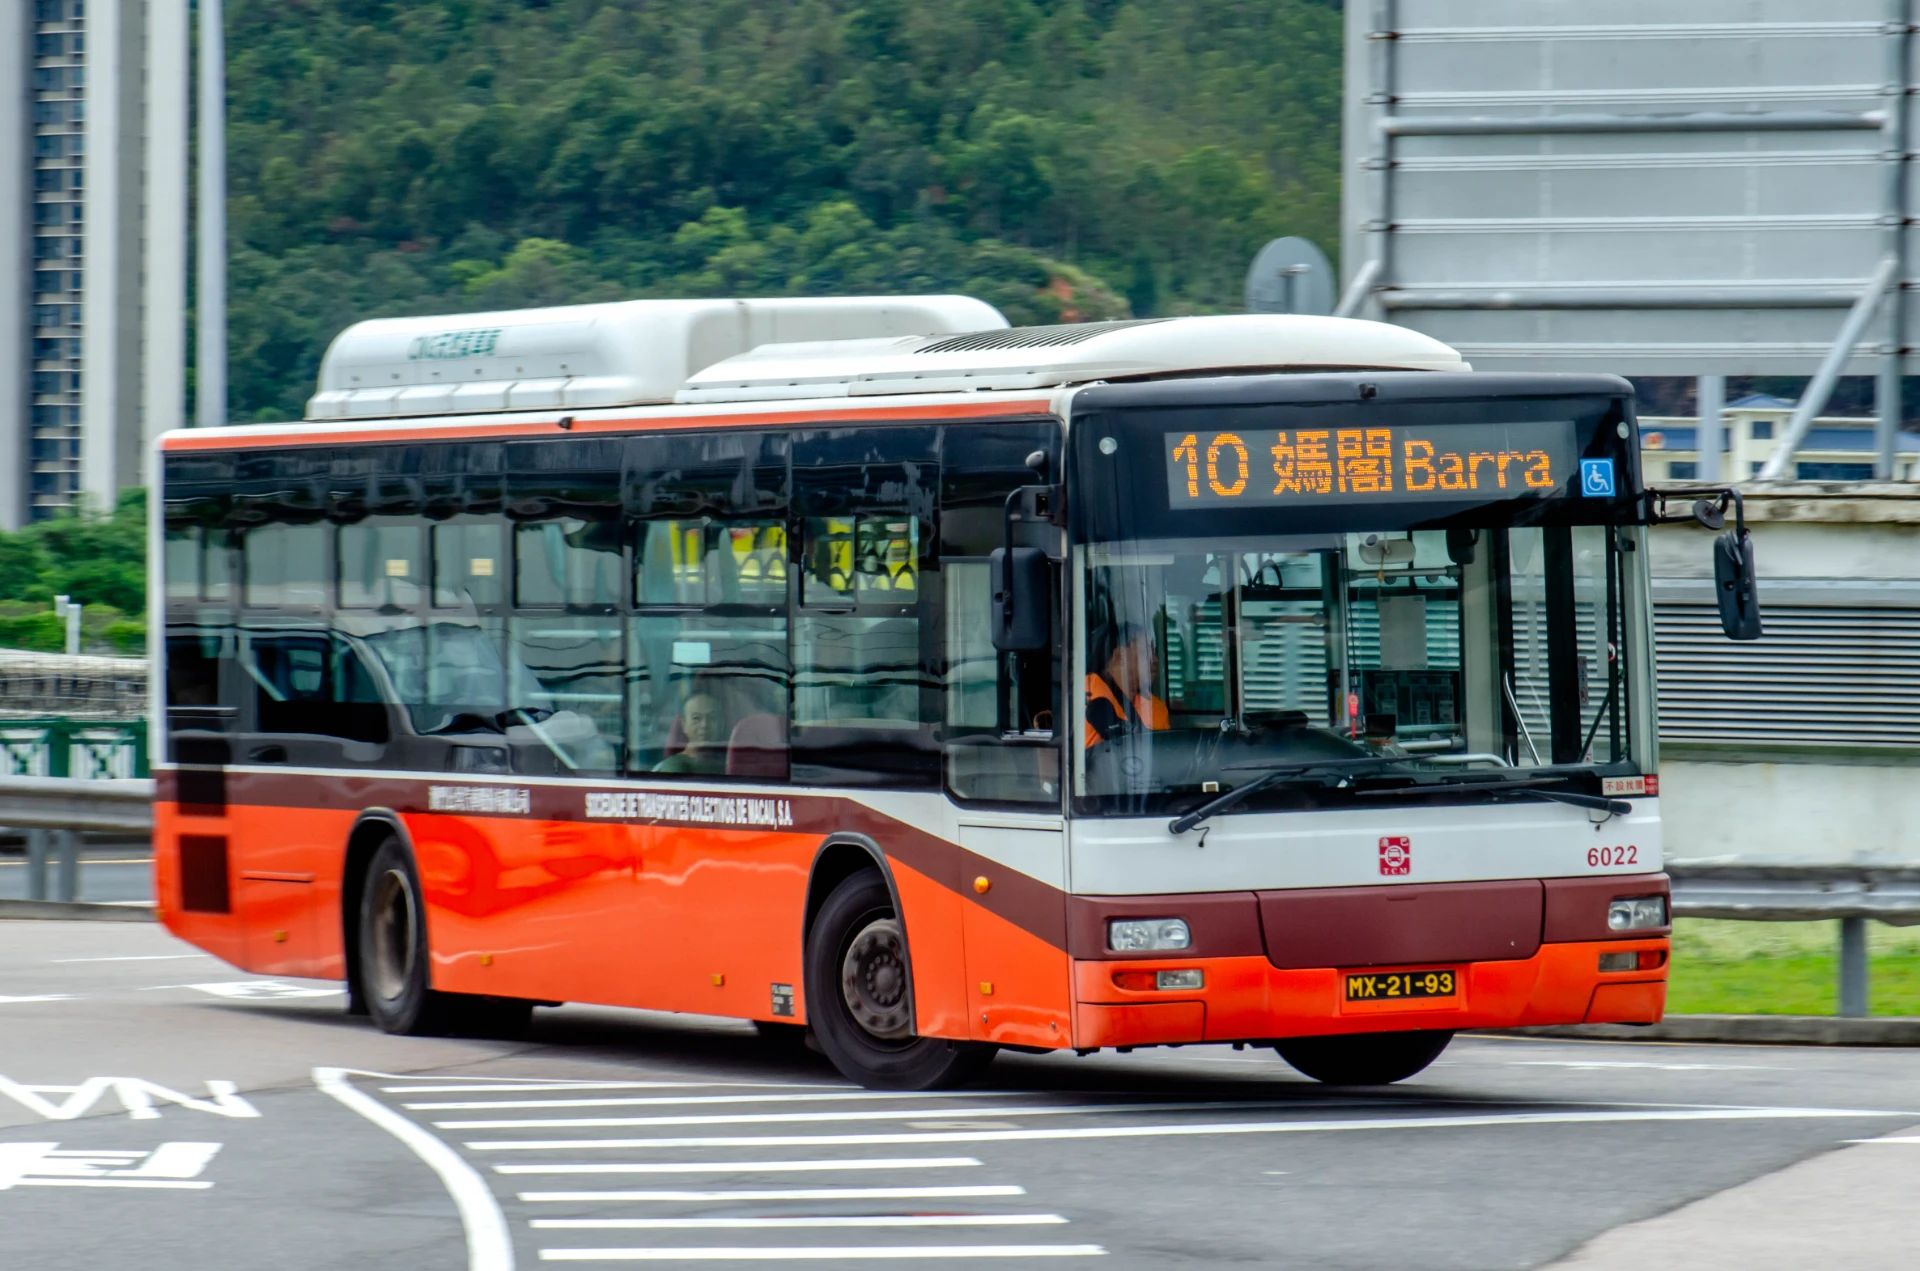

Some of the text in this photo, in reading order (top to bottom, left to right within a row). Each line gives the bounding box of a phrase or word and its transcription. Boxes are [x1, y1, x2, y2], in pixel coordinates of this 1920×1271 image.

[1172, 428, 1555, 498] 10 媽閣 Barra
[736, 798, 747, 825] DE
[1587, 845, 1638, 867] 6022
[1348, 973, 1453, 998] MX-21-93
